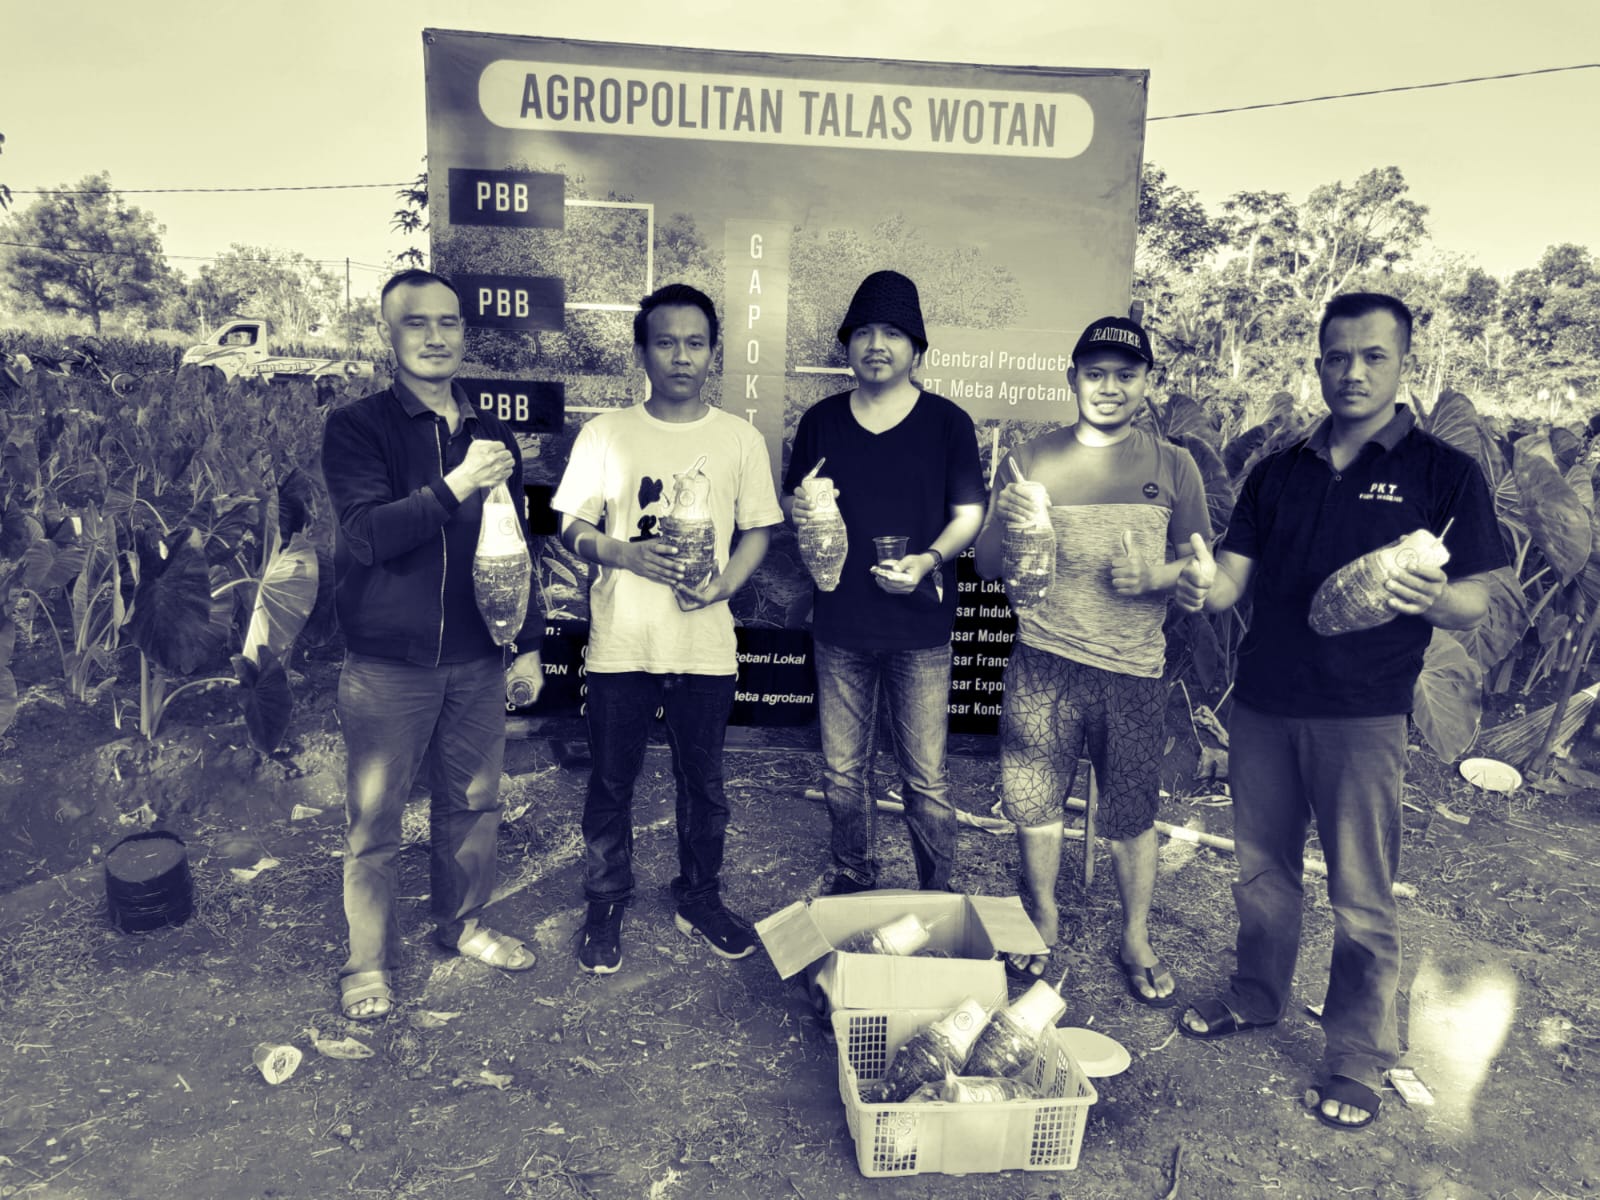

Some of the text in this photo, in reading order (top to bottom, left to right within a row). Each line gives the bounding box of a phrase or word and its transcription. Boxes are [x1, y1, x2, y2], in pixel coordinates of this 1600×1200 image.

[520, 73, 1057, 148] AGROPOLITAN TALAS WOTAN
[477, 181, 529, 213] PBB
[479, 288, 529, 318] PBB
[745, 233, 763, 426] GAPOKT
[998, 351, 1071, 372] Producti
[950, 379, 993, 399] Meta
[998, 381, 1070, 405] Agrotani
[481, 393, 529, 421] PBB
[957, 580, 1006, 593] sar Loka
[956, 604, 1012, 618] sar Induk
[951, 629, 1016, 643] sar Moder
[773, 653, 806, 665] Lokal
[953, 653, 1009, 667] sar Franc
[952, 680, 972, 690] sar
[762, 694, 814, 706] agrotani
[947, 701, 1002, 716] sar Kont
